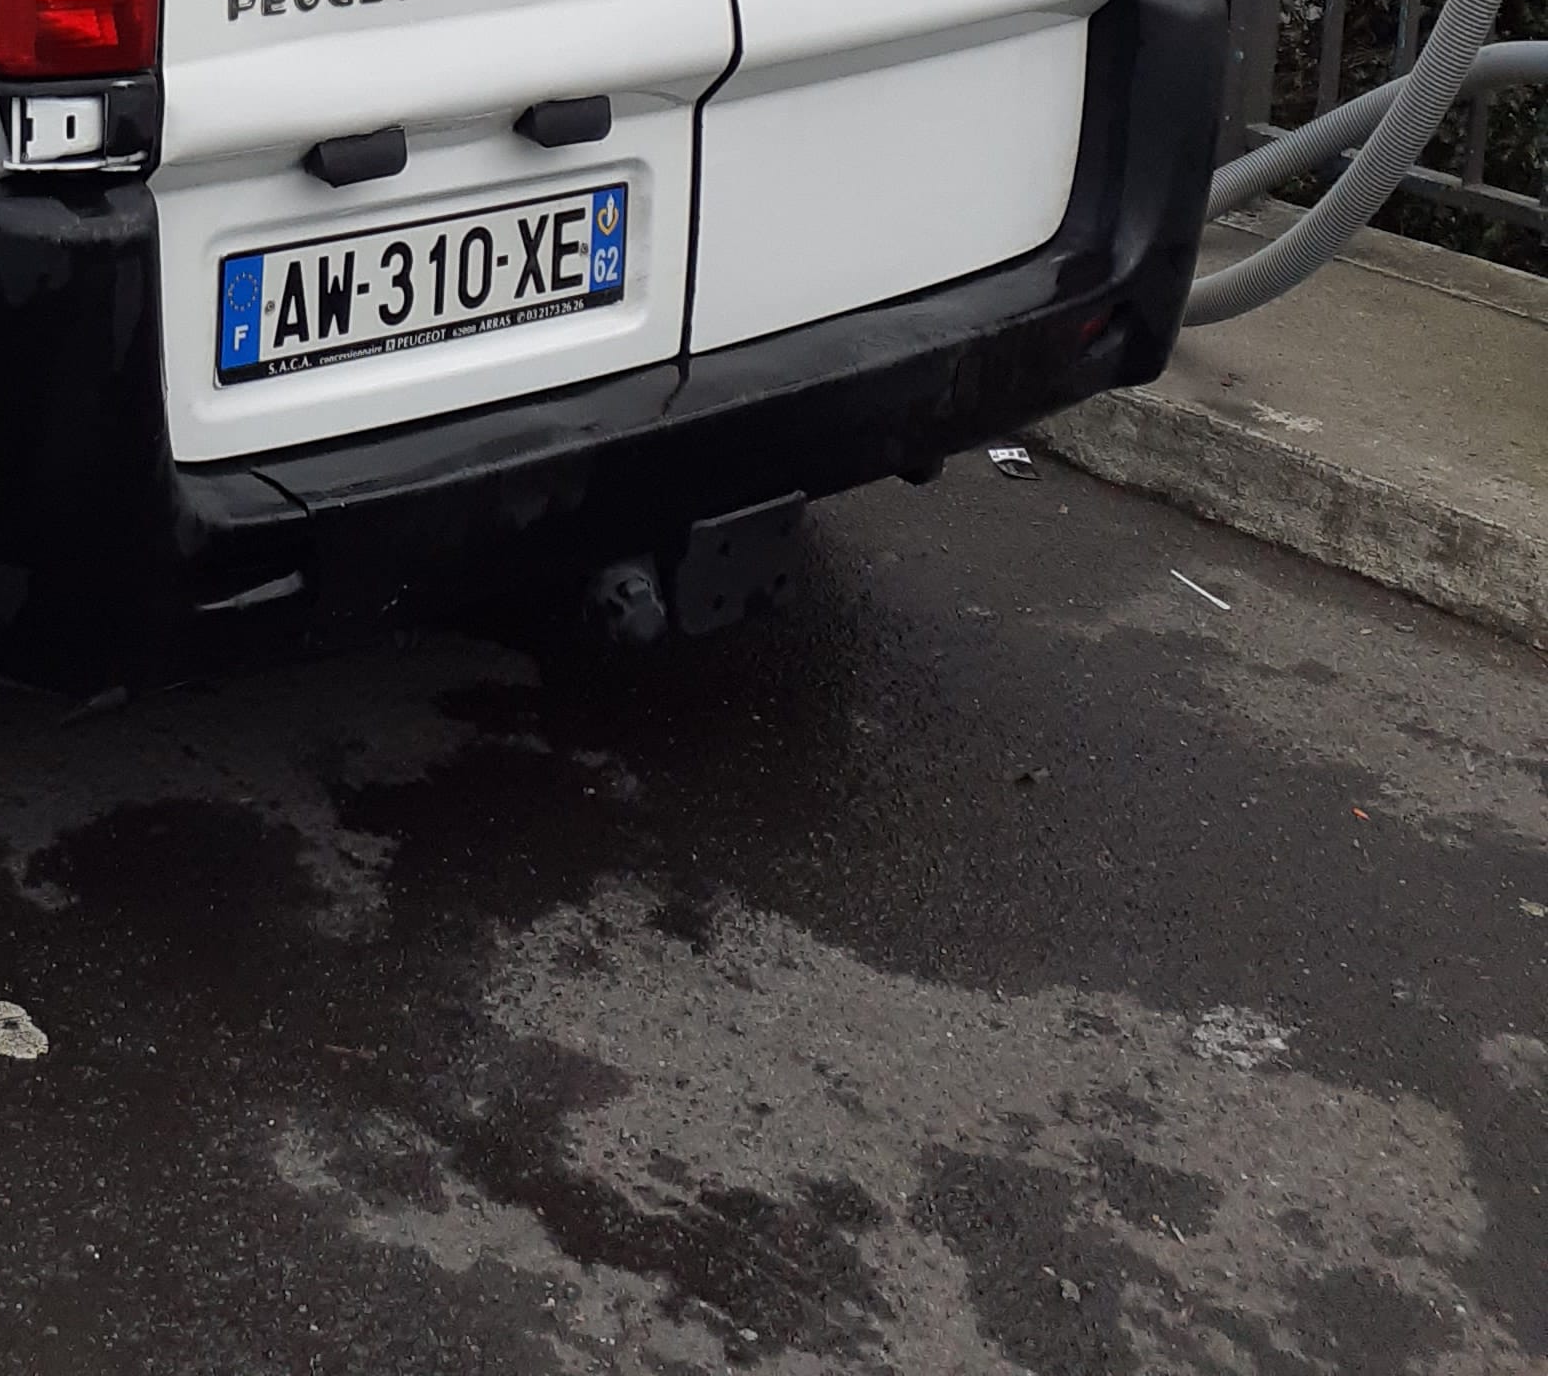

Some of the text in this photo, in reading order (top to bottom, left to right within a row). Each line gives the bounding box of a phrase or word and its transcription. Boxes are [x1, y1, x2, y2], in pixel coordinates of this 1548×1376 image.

[233, 207, 586, 352] F AW-310-XE
[594, 245, 620, 283] 62
[268, 355, 312, 376] S.A.C.A.
[397, 328, 447, 349] PEUGEOT
[478, 314, 512, 333] ARRAS
